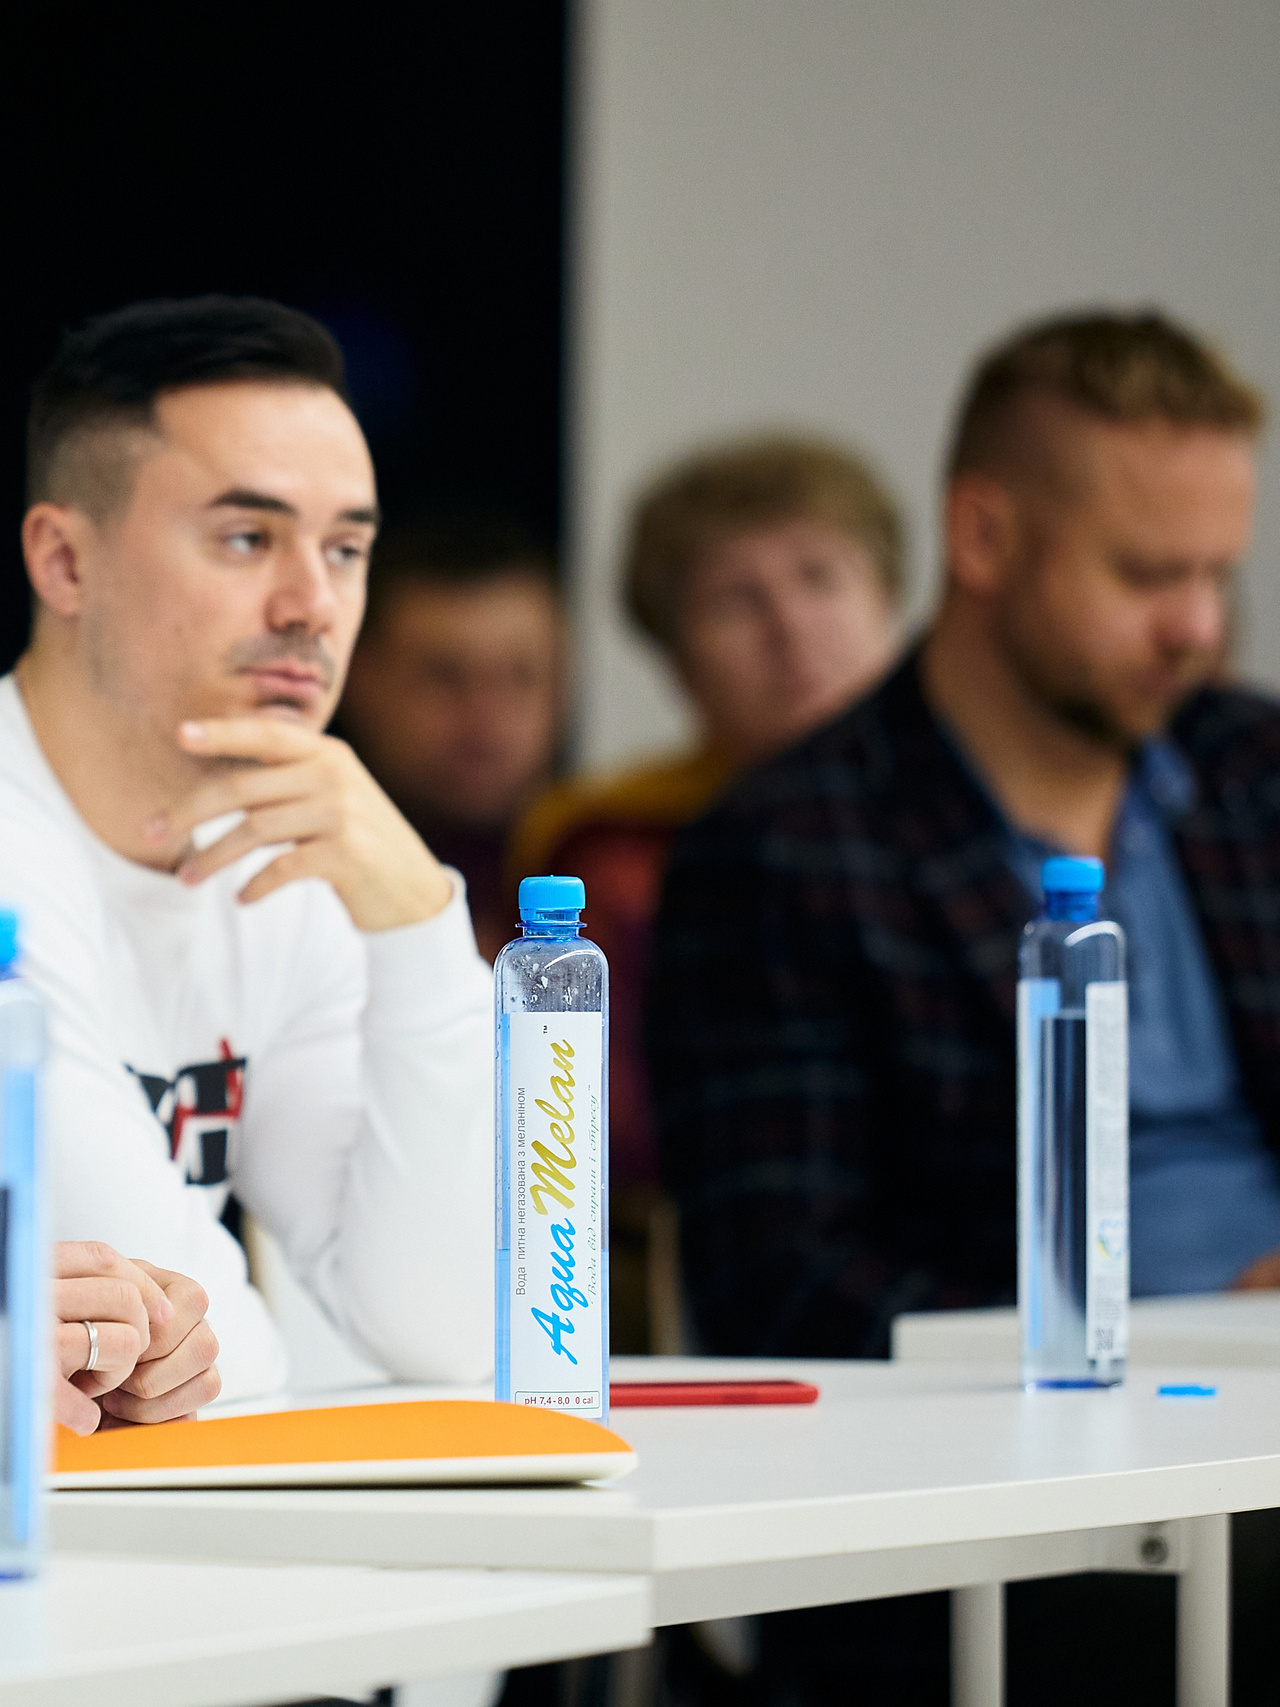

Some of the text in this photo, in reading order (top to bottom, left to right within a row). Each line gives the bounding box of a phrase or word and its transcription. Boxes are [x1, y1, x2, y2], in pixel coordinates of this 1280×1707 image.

[515, 1087, 526, 1148] меланіном
[529, 1039, 577, 1215] Melan
[587, 1094, 600, 1152] стресу
[517, 1160, 526, 1224] негазована
[517, 1227, 526, 1260] питна
[587, 1226, 597, 1251] від
[515, 1266, 526, 1296] Вода
[530, 1218, 589, 1366] Aqua
[587, 1257, 598, 1305] Вода
[524, 1396, 537, 1406] pH
[575, 1396, 580, 1405] 0
[582, 1396, 594, 1404] cal
